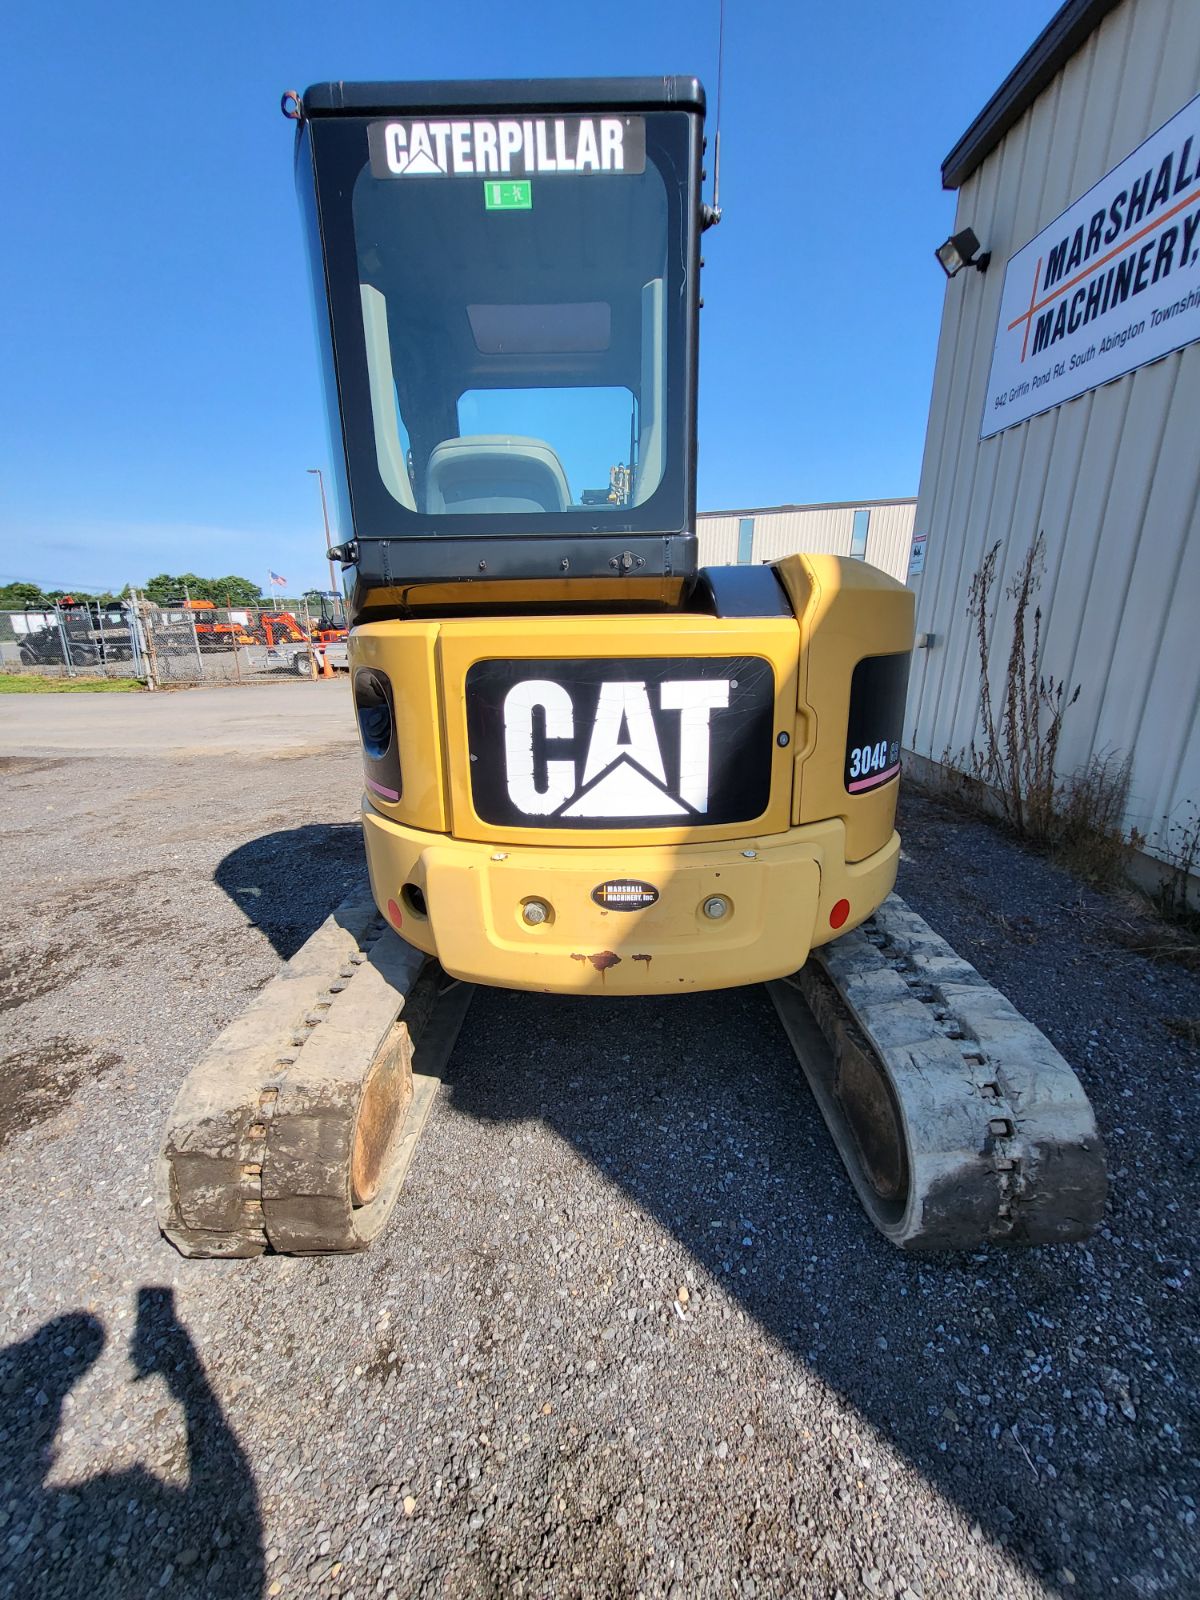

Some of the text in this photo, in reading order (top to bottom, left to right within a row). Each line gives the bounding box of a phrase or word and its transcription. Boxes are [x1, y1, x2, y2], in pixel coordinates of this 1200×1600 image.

[384, 119, 625, 174] CATERPILLAR
[1043, 134, 1200, 291] MARSHAL
[1031, 208, 1200, 357] MACHINERY,
[994, 391, 1007, 410] 942
[1008, 379, 1030, 402] Griffin
[1032, 367, 1051, 391] Pond
[1052, 361, 1066, 380] Rd.
[1069, 346, 1096, 371] South
[1098, 320, 1146, 358] Abington
[503, 679, 730, 818] CAT
[849, 740, 887, 778] 304C
